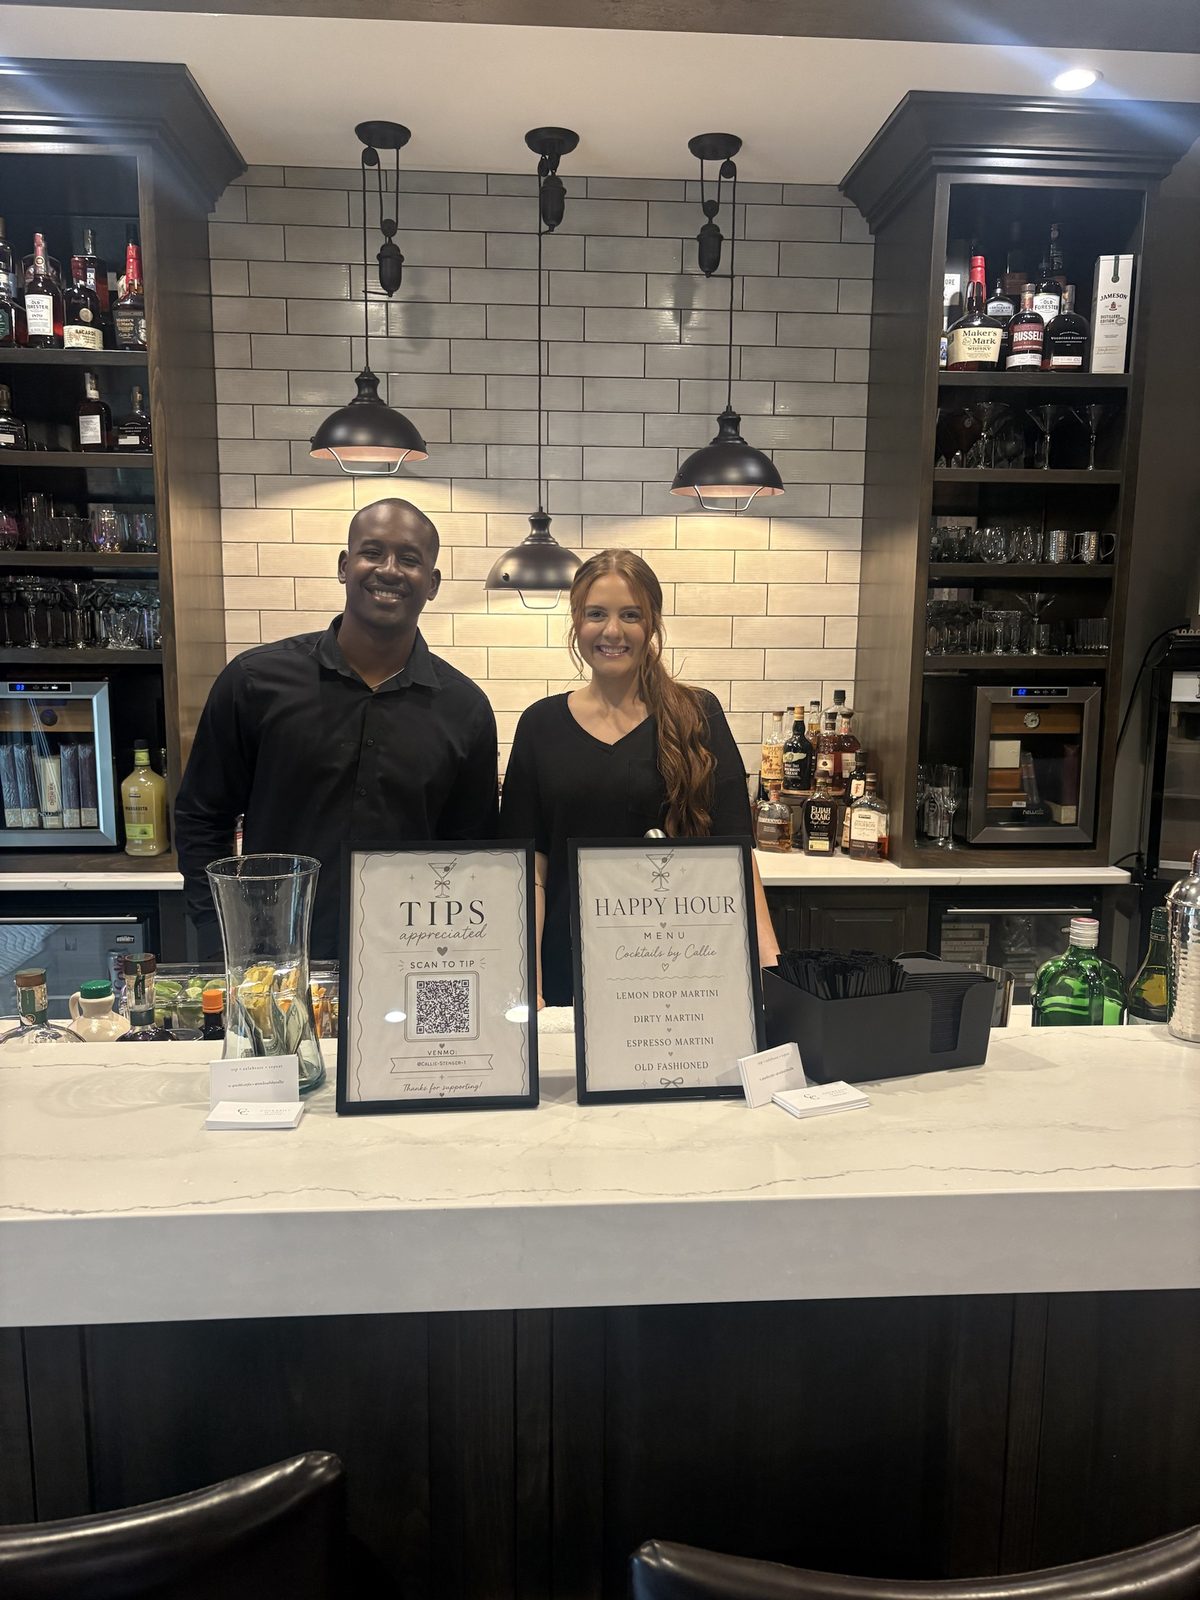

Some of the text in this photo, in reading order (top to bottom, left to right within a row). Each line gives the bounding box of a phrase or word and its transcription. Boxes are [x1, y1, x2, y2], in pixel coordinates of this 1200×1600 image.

[1100, 292, 1129, 301] JAMESON
[972, 337, 997, 345] Mark
[811, 805, 831, 814] ELIJAH
[810, 812, 831, 821] CRAIG
[595, 895, 737, 916] HAPPY HOUR
[400, 899, 485, 926] TIPS
[399, 922, 487, 947] appreciated
[643, 931, 686, 940] MENU
[615, 943, 717, 962] Cocktails by Callie
[410, 959, 475, 969] SCAN TO TIP
[616, 989, 719, 1000] LEMON DROP MARTINI
[633, 1013, 705, 1024] DIRTY MARTINI
[626, 1037, 714, 1047] ESPRESSO MARTINI
[634, 1060, 709, 1072] OLD FASHIONED
[403, 1081, 483, 1094] Thanks for supporting!
